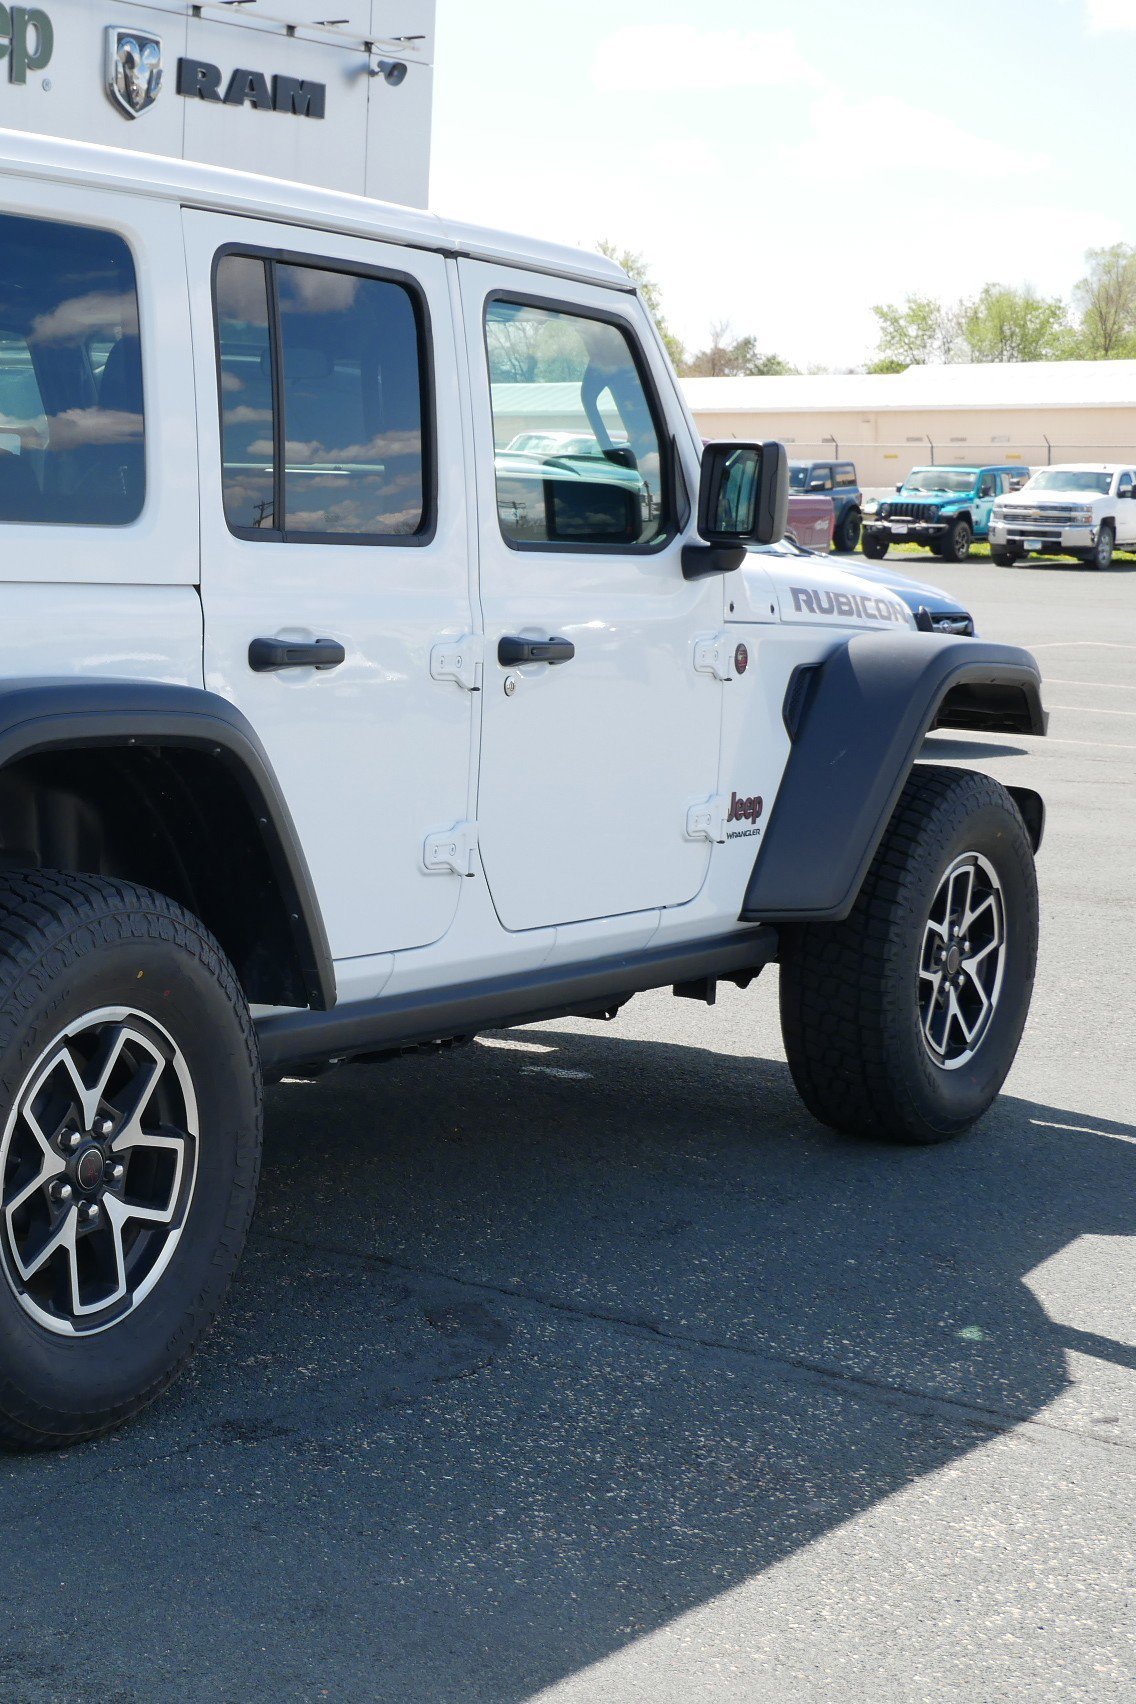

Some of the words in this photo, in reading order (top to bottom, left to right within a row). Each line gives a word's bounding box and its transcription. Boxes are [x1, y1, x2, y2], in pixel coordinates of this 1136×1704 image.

[176, 57, 326, 119] RAM
[789, 586, 909, 624] RUBICON
[727, 792, 763, 824] Jeep
[726, 828, 761, 840] WRANGLER
